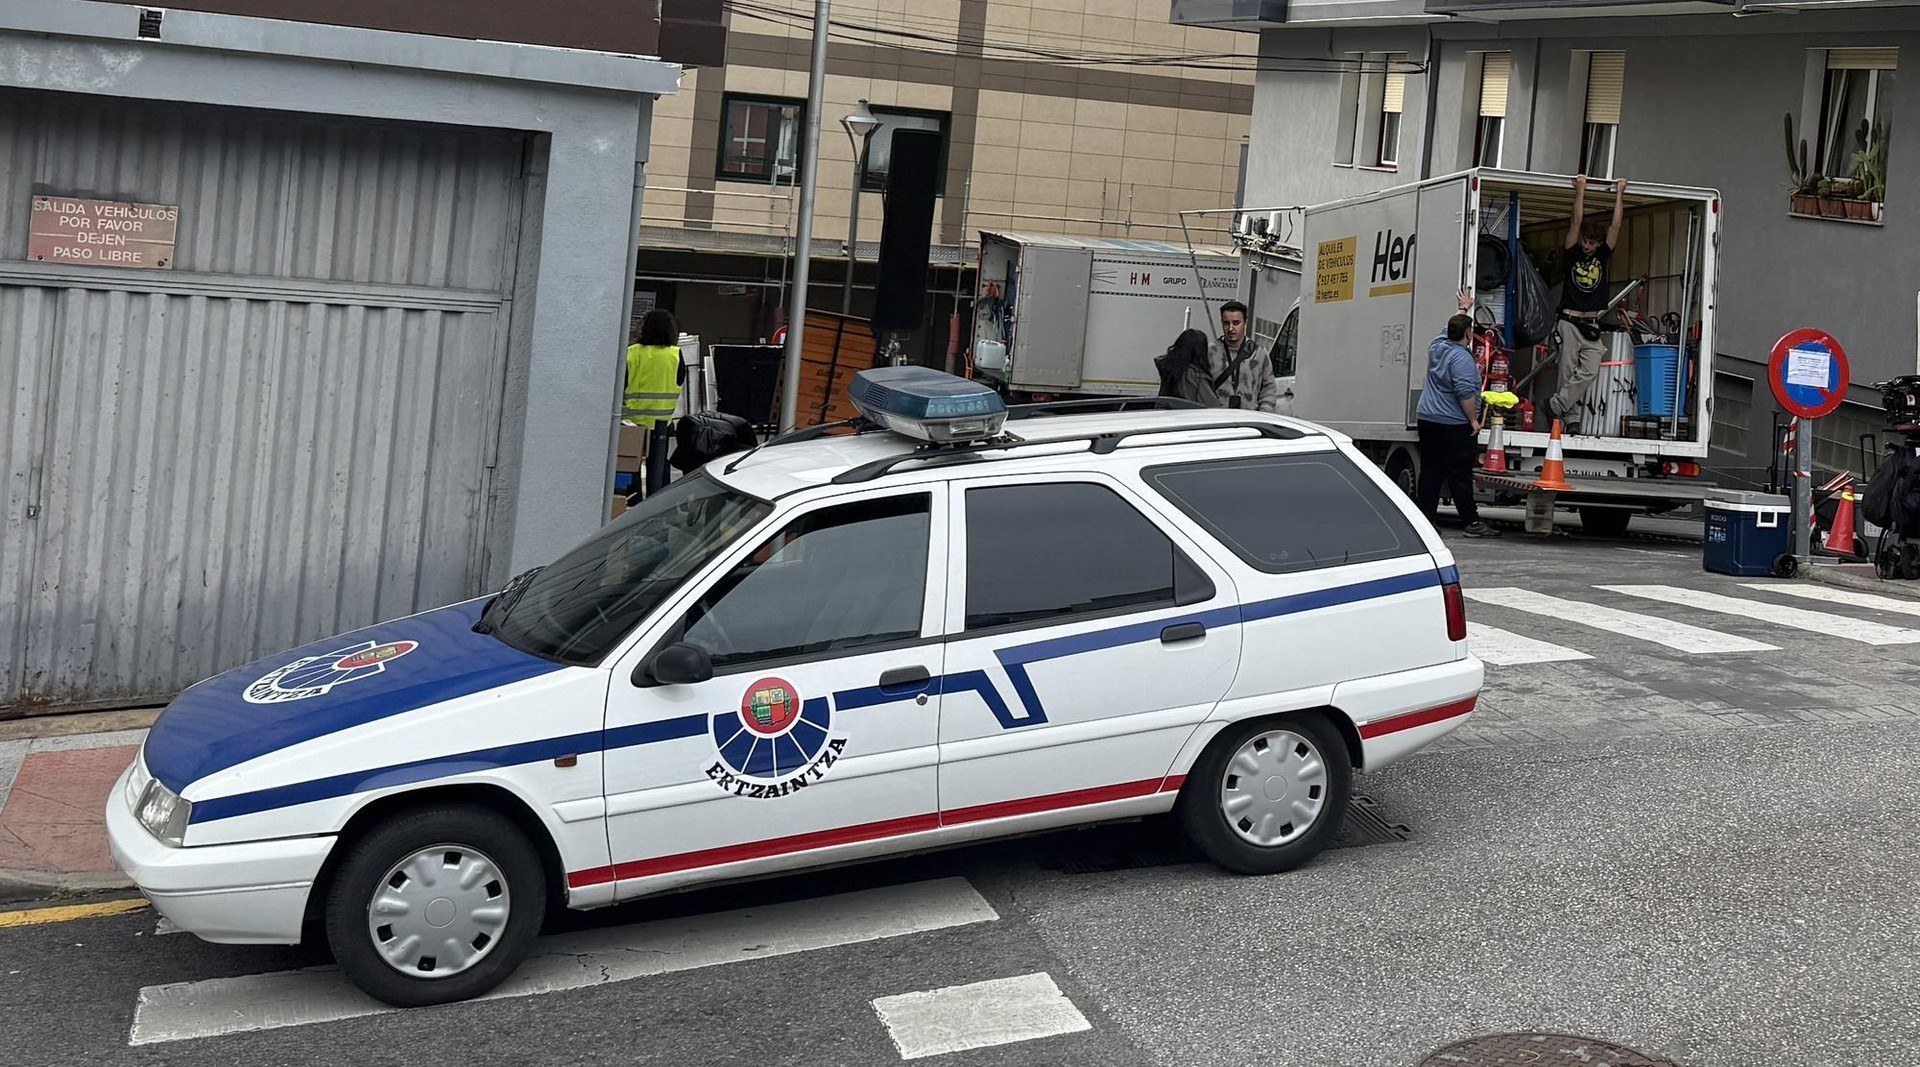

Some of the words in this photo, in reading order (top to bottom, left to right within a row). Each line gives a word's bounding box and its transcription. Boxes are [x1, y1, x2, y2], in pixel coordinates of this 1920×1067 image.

[33, 200, 86, 215] SALIDA
[94, 205, 176, 221] VEHICULOS
[59, 216, 91, 229] POR
[97, 219, 143, 232] FAVOR
[77, 232, 126, 246] DEJEN
[53, 247, 93, 259] PASO
[100, 250, 143, 263] LIBRE
[1371, 229, 1415, 283] Her
[1163, 277, 1187, 285] GRUPO
[705, 738, 848, 799] ERTZAINTZA
